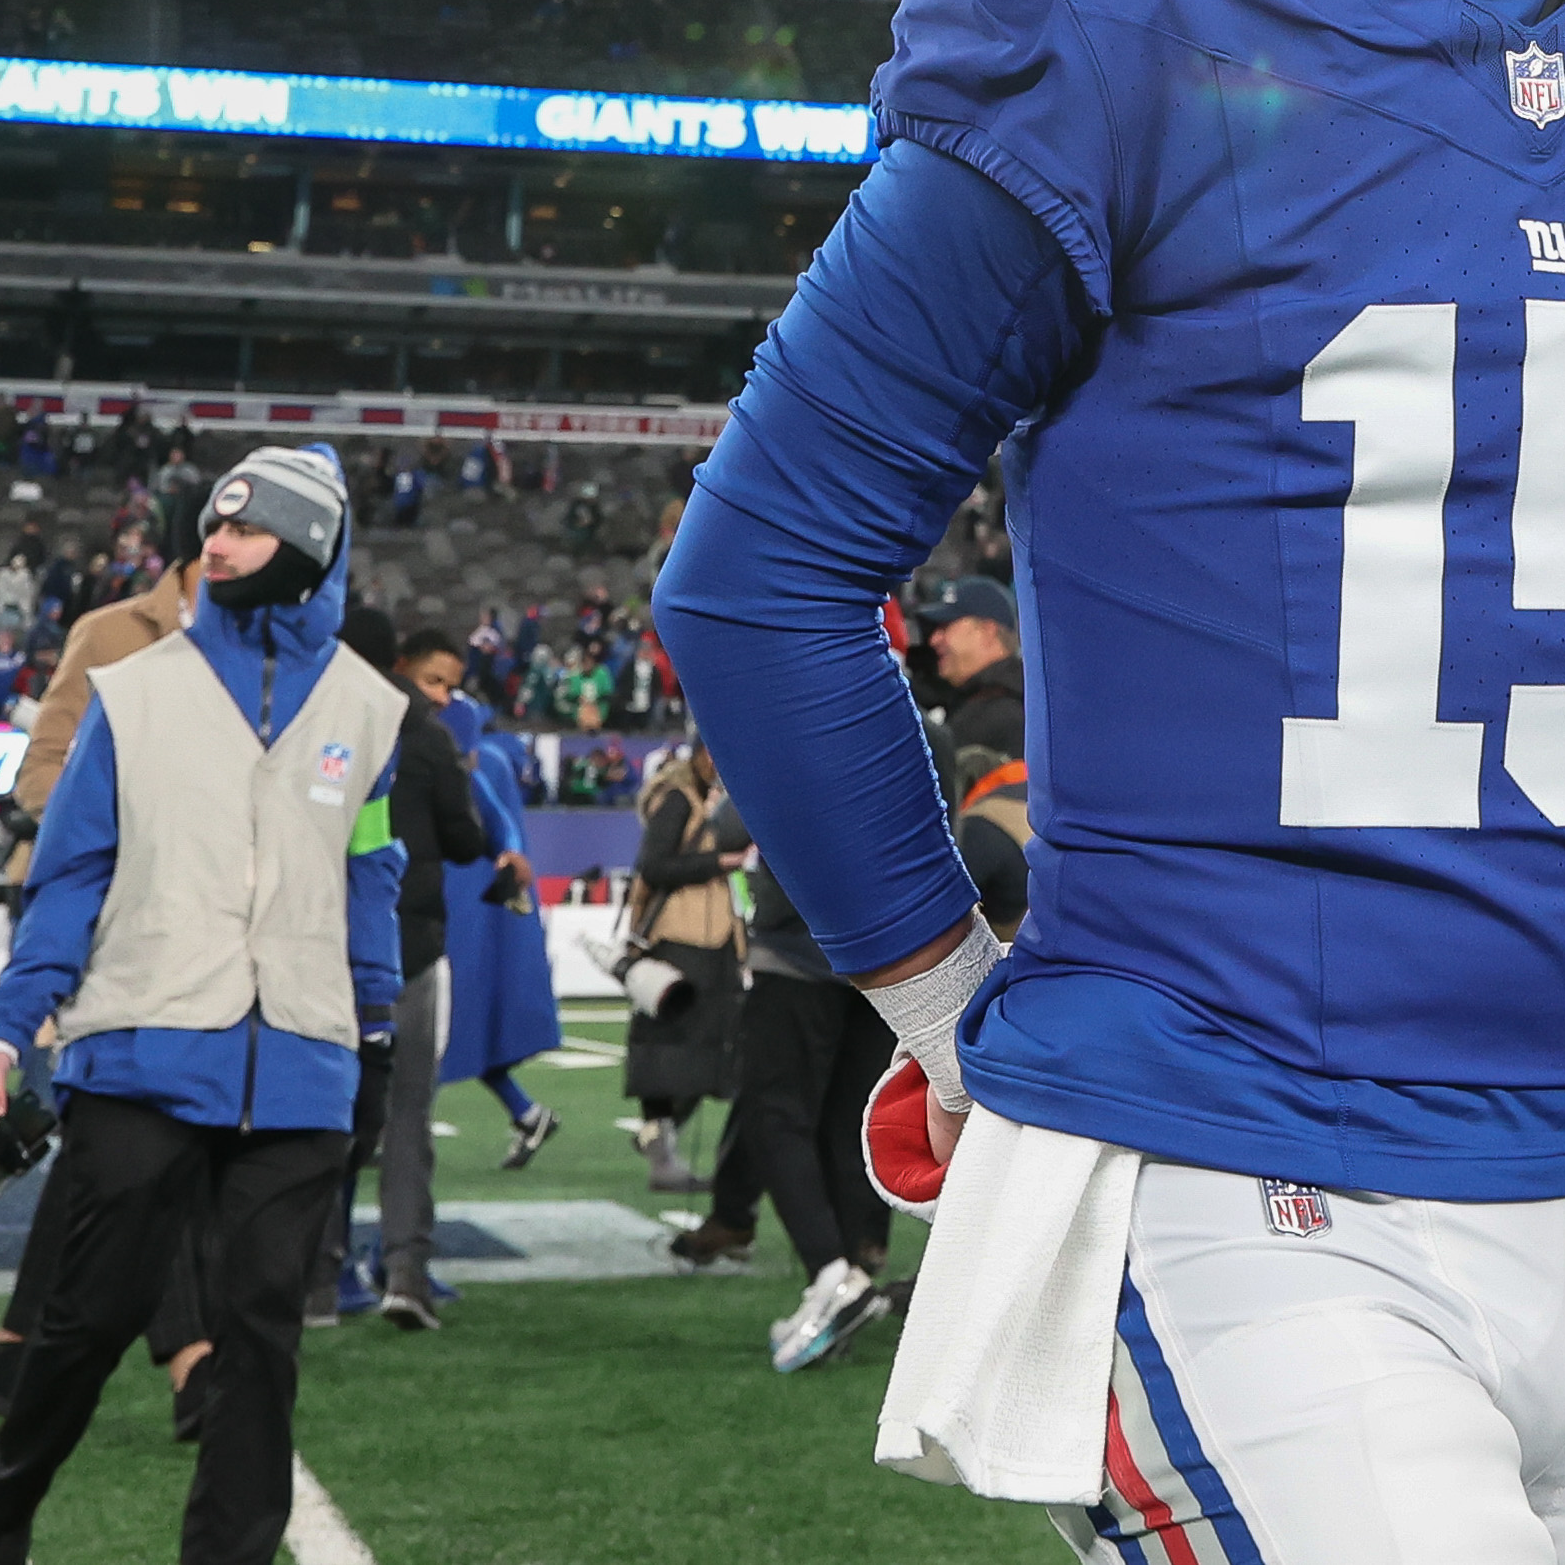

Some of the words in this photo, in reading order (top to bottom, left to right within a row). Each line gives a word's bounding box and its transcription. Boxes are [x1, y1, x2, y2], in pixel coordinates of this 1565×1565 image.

[168, 73, 289, 125] WIN
[1520, 81, 1559, 112] NFL
[536, 95, 747, 148] GIANTS
[753, 104, 868, 155] WIN
[1273, 1198, 1325, 1230] NFL
